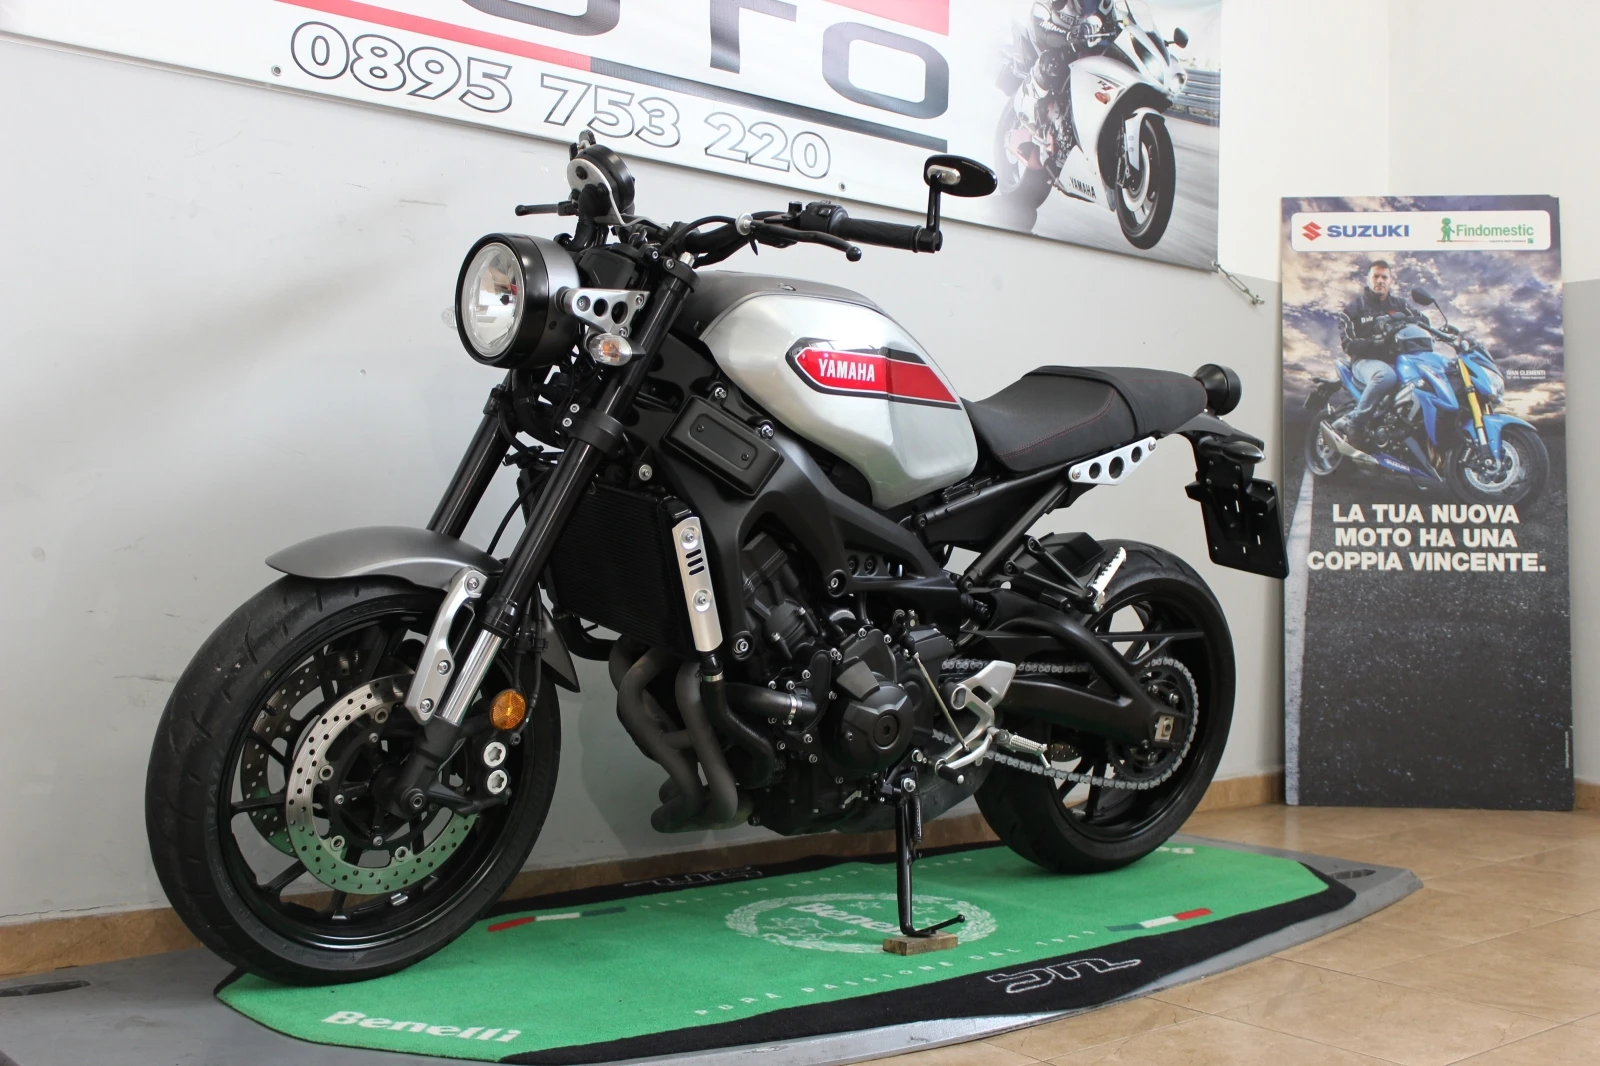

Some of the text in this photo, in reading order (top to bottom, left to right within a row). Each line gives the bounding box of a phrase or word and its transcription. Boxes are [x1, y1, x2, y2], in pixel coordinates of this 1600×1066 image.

[291, 21, 831, 179] 0895 753 220
[1069, 175, 1097, 199] YAMAHA
[1327, 224, 1410, 238] SUZUKI
[1456, 224, 1534, 237] Findomestic
[818, 358, 875, 382] YAMAHA
[1332, 503, 1520, 524] LA TUA NUOVA
[1335, 527, 1518, 548] MOTO HA UNA
[1307, 551, 1547, 572] COPPIA VINCENTE.
[320, 1010, 522, 1043] Benelli
